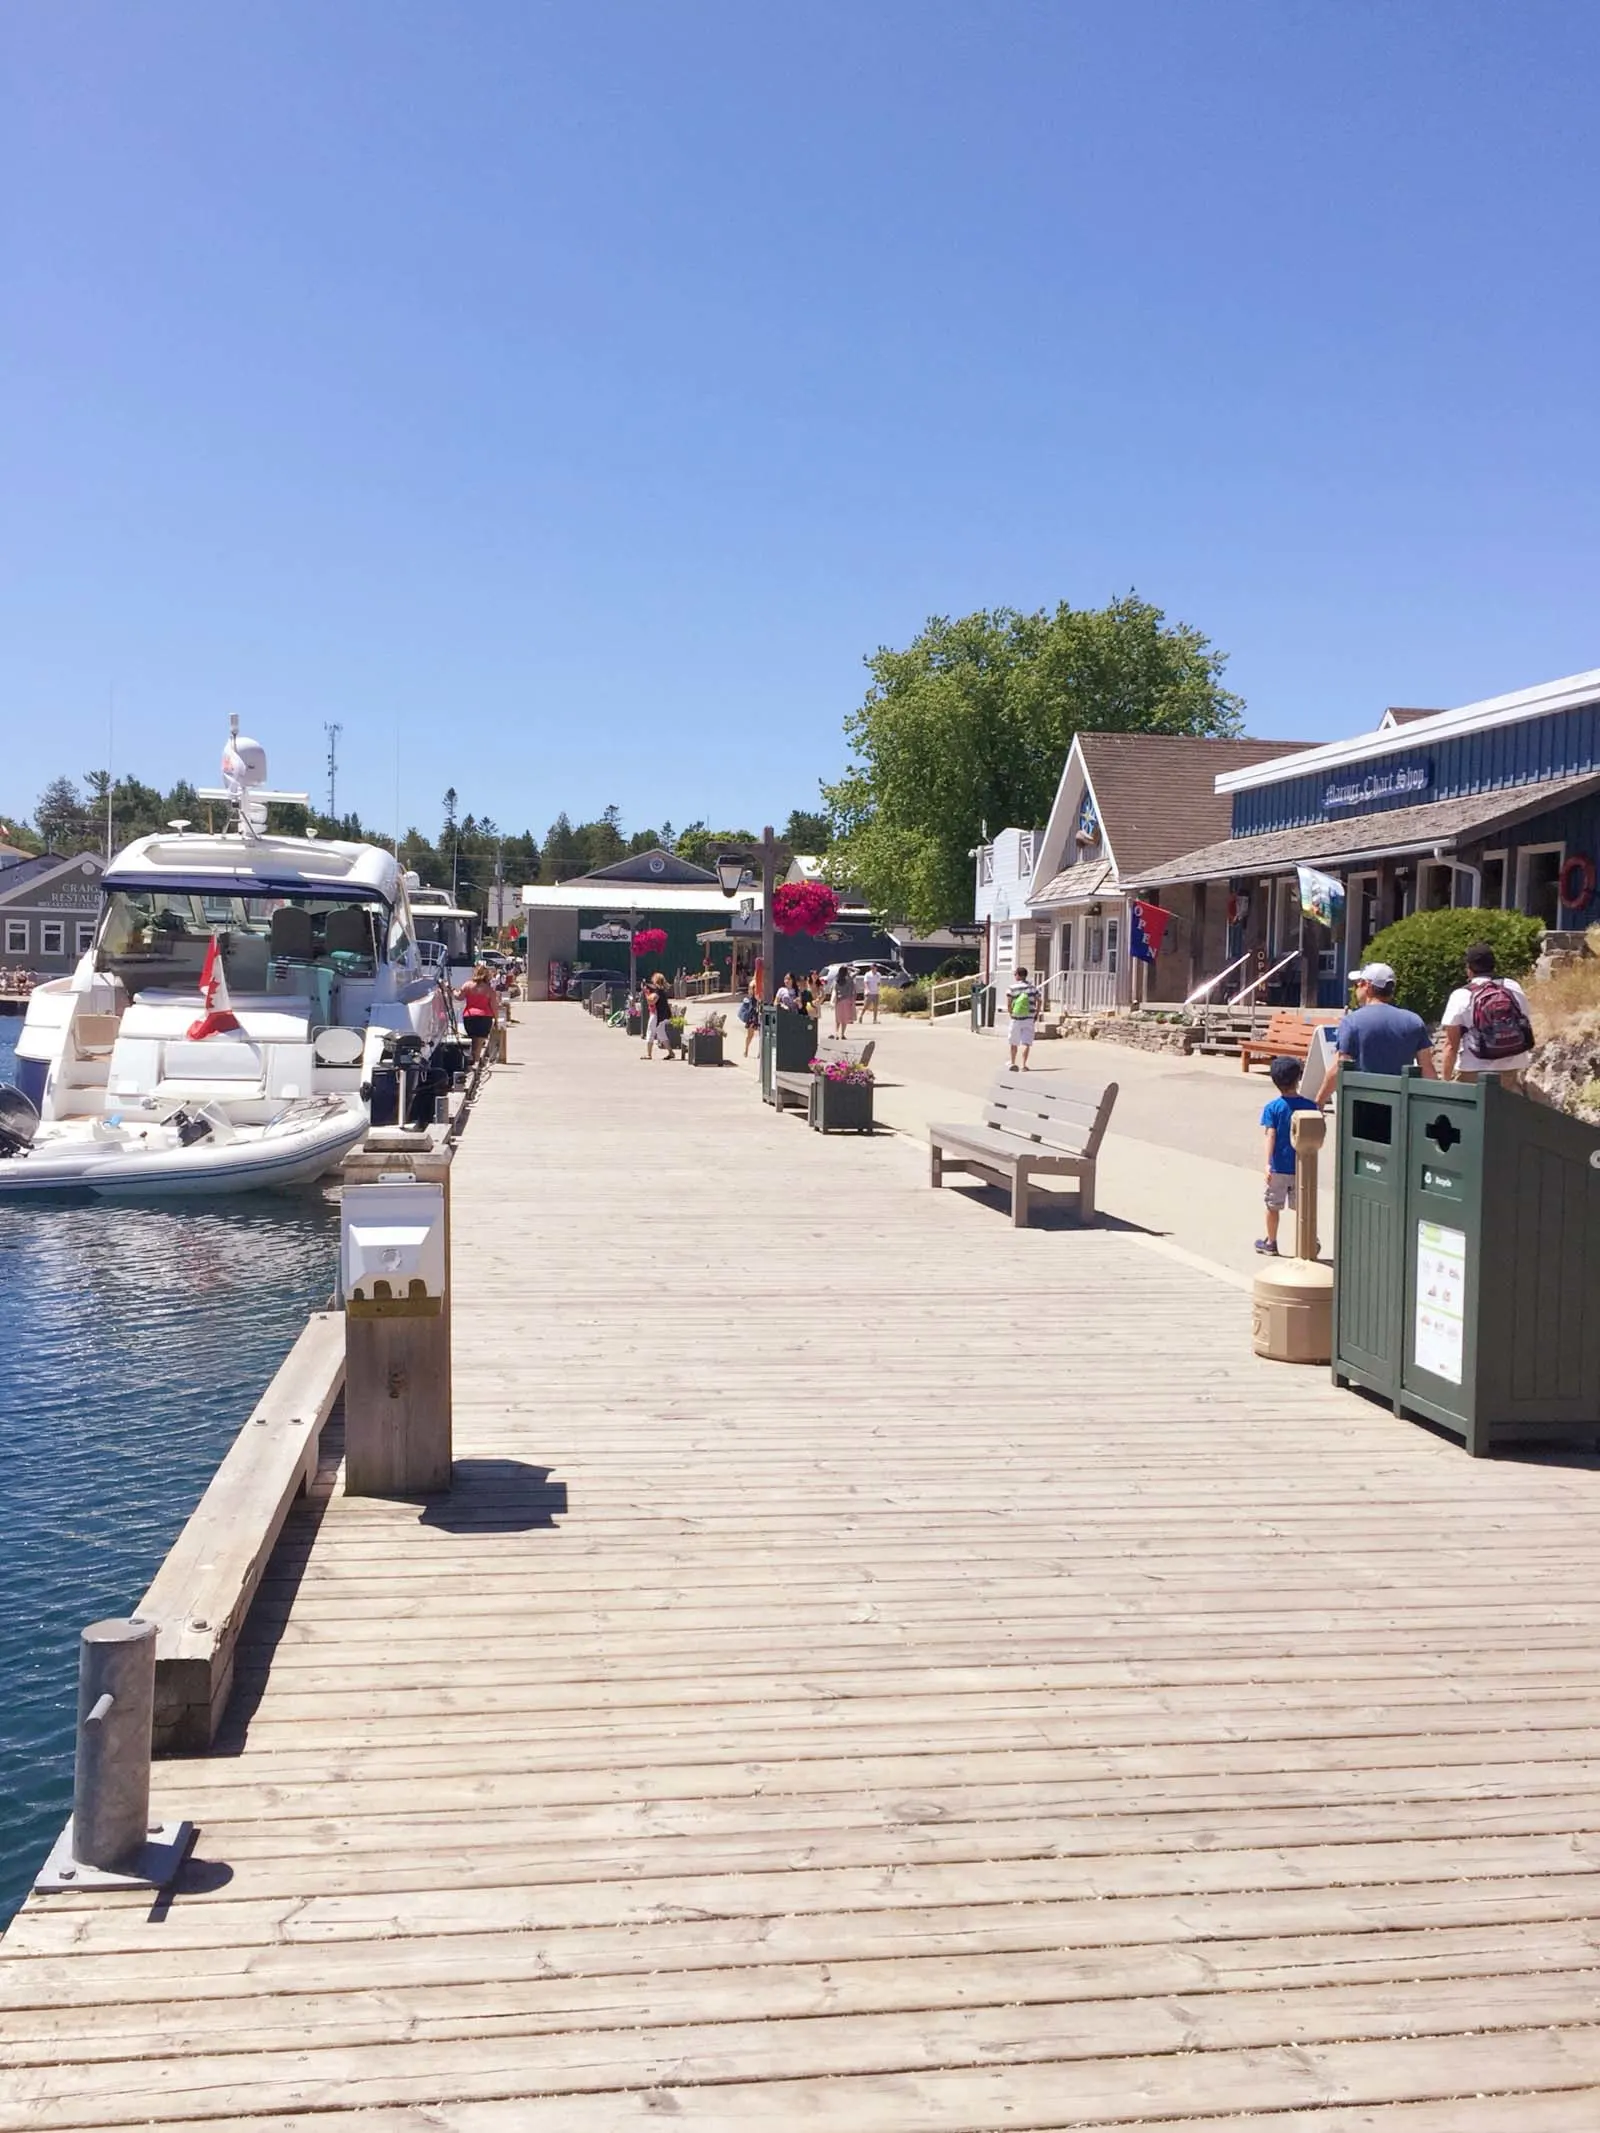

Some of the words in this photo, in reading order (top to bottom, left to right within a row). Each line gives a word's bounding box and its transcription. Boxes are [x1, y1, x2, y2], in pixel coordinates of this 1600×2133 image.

[1325, 783, 1360, 805] Mariner
[1363, 772, 1394, 798] Chart
[1395, 766, 1425, 791] Shop
[1134, 904, 1157, 959] OPEN
